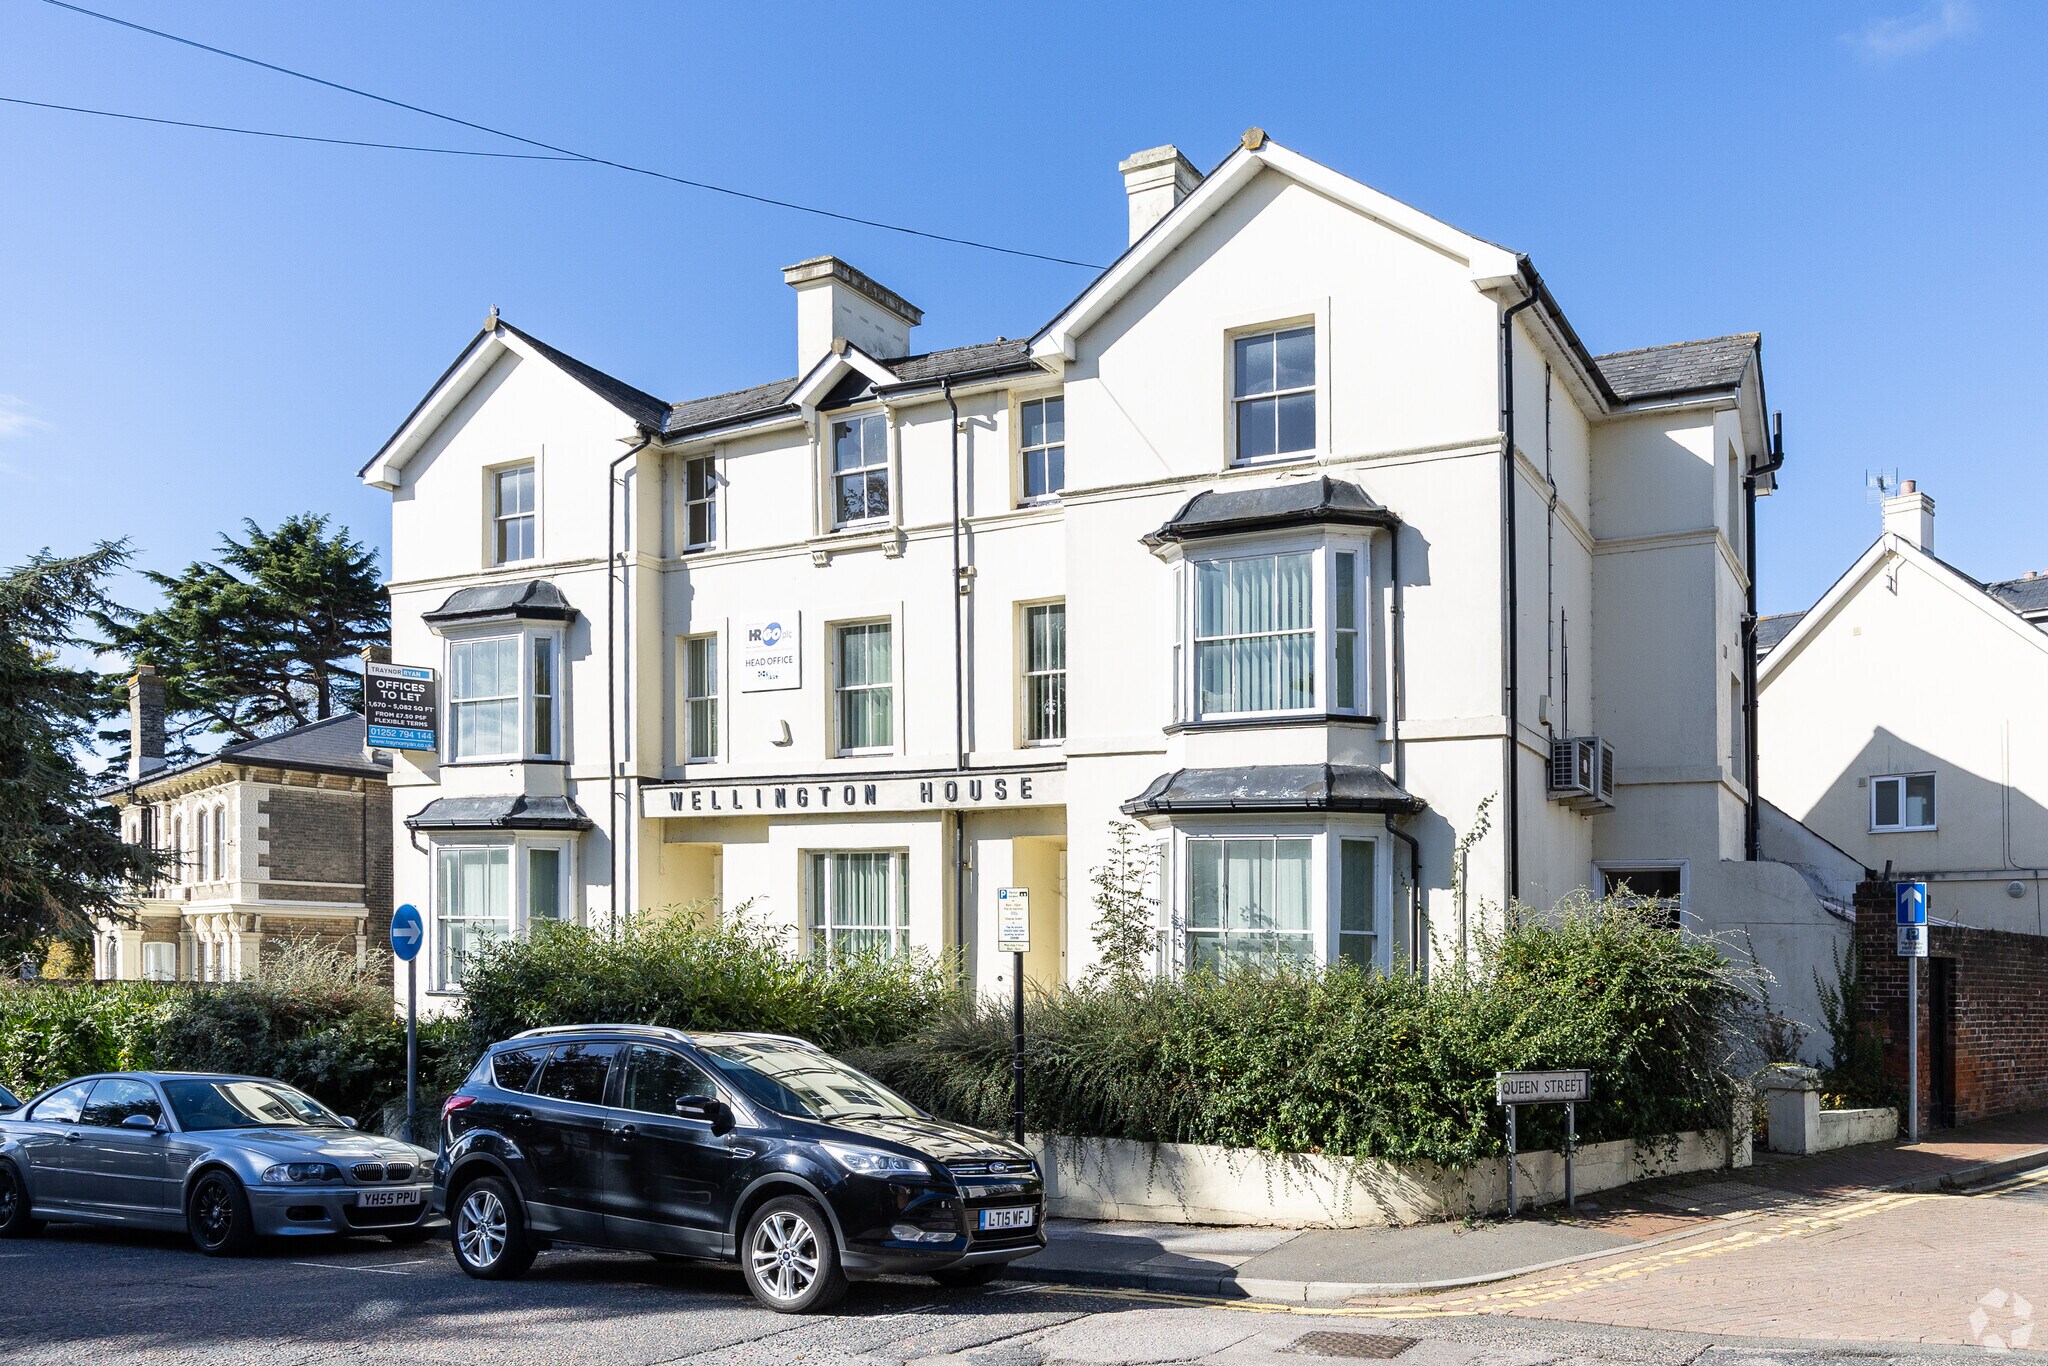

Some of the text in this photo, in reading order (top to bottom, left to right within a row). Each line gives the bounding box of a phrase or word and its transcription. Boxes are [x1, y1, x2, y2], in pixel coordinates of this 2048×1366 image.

[745, 656, 793, 667] HEAD OFFICE
[371, 666, 421, 678] TRAYNOR RYAN
[376, 680, 425, 692] OFFICES
[380, 690, 421, 702] TO LET
[371, 728, 397, 737] 01252
[399, 730, 414, 738] 794
[669, 777, 1032, 811] WELLINGTON HOUSE
[1503, 1079, 1583, 1095] QUEEN STREET
[365, 1192, 417, 1205] YH55 PPU
[1013, 1210, 1029, 1224] WFJ
